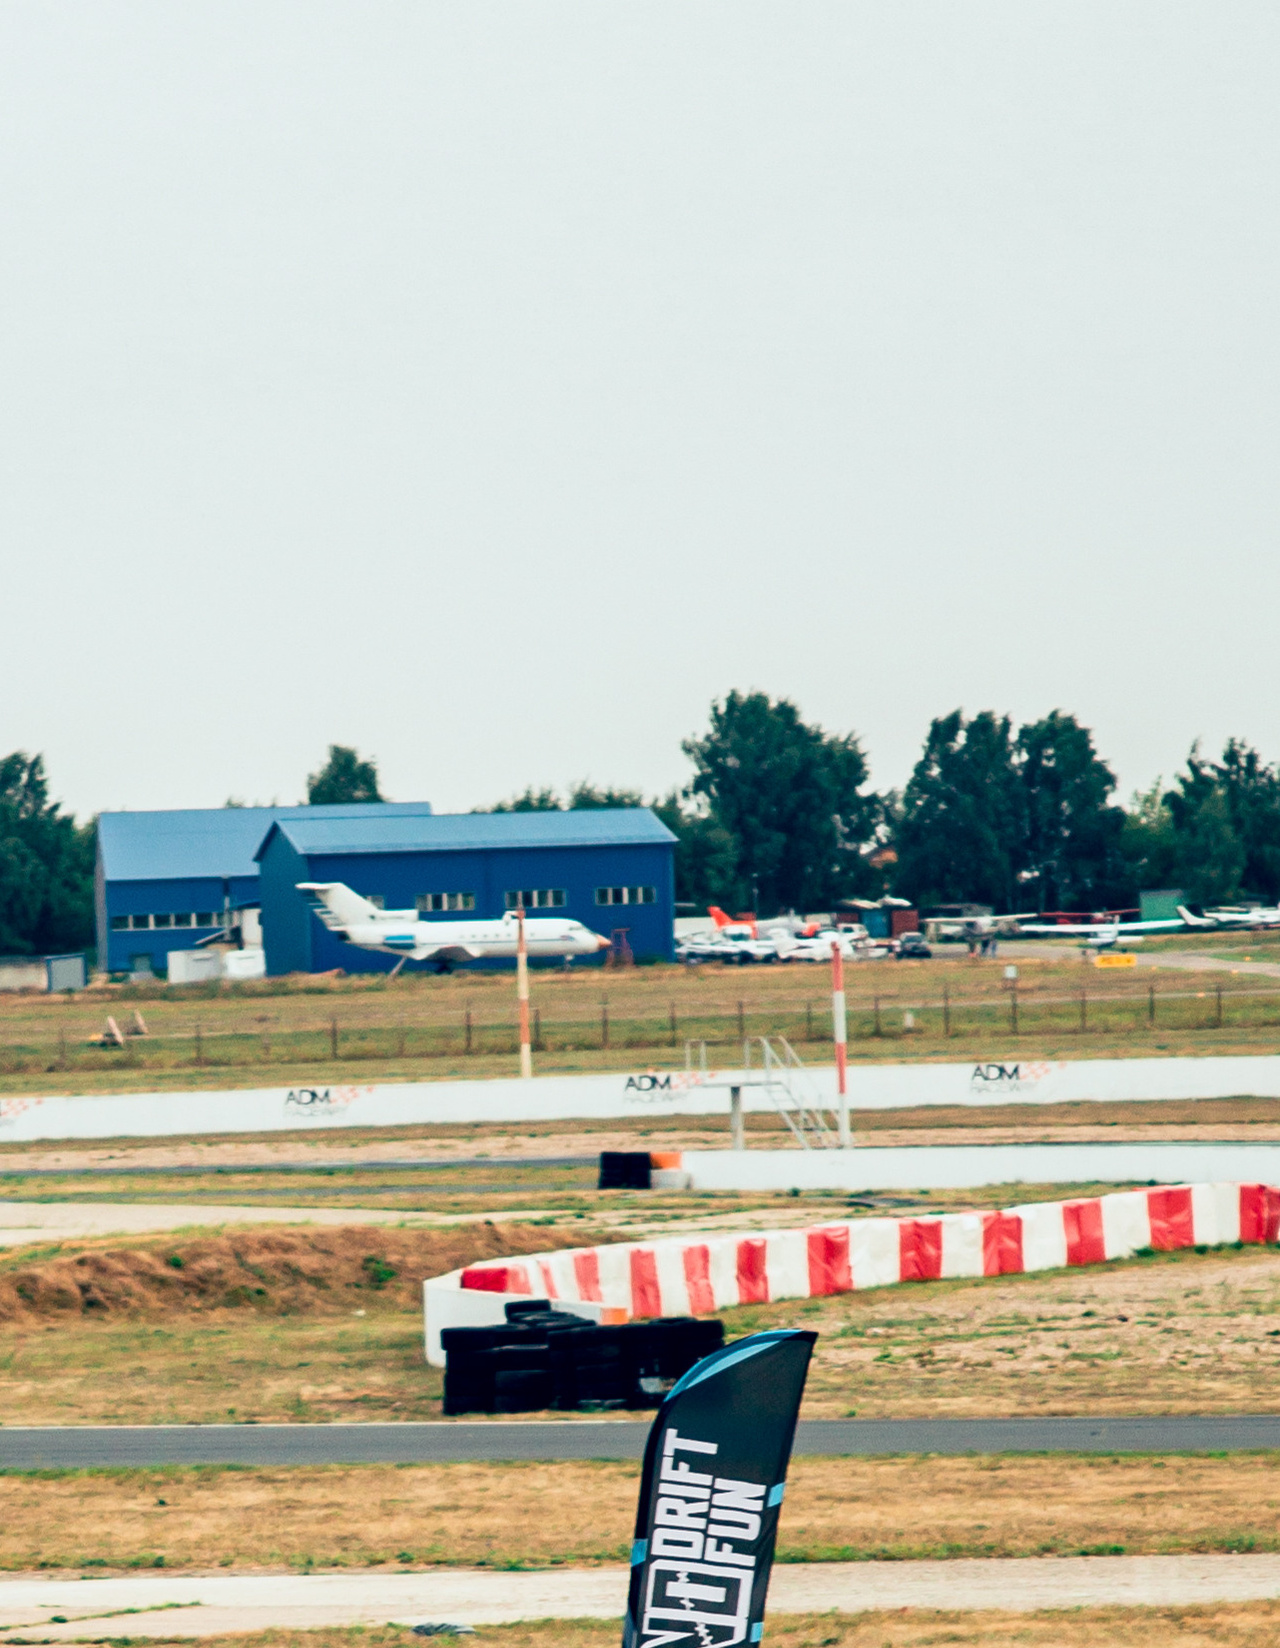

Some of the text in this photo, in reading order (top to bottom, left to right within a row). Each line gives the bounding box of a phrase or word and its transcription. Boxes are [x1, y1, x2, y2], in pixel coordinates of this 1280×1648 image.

[972, 1064, 1019, 1081] ADM
[625, 1075, 671, 1091] ADM
[285, 1087, 331, 1105] ADM
[651, 1428, 718, 1560] DRIFT
[704, 1478, 767, 1567] FUN
